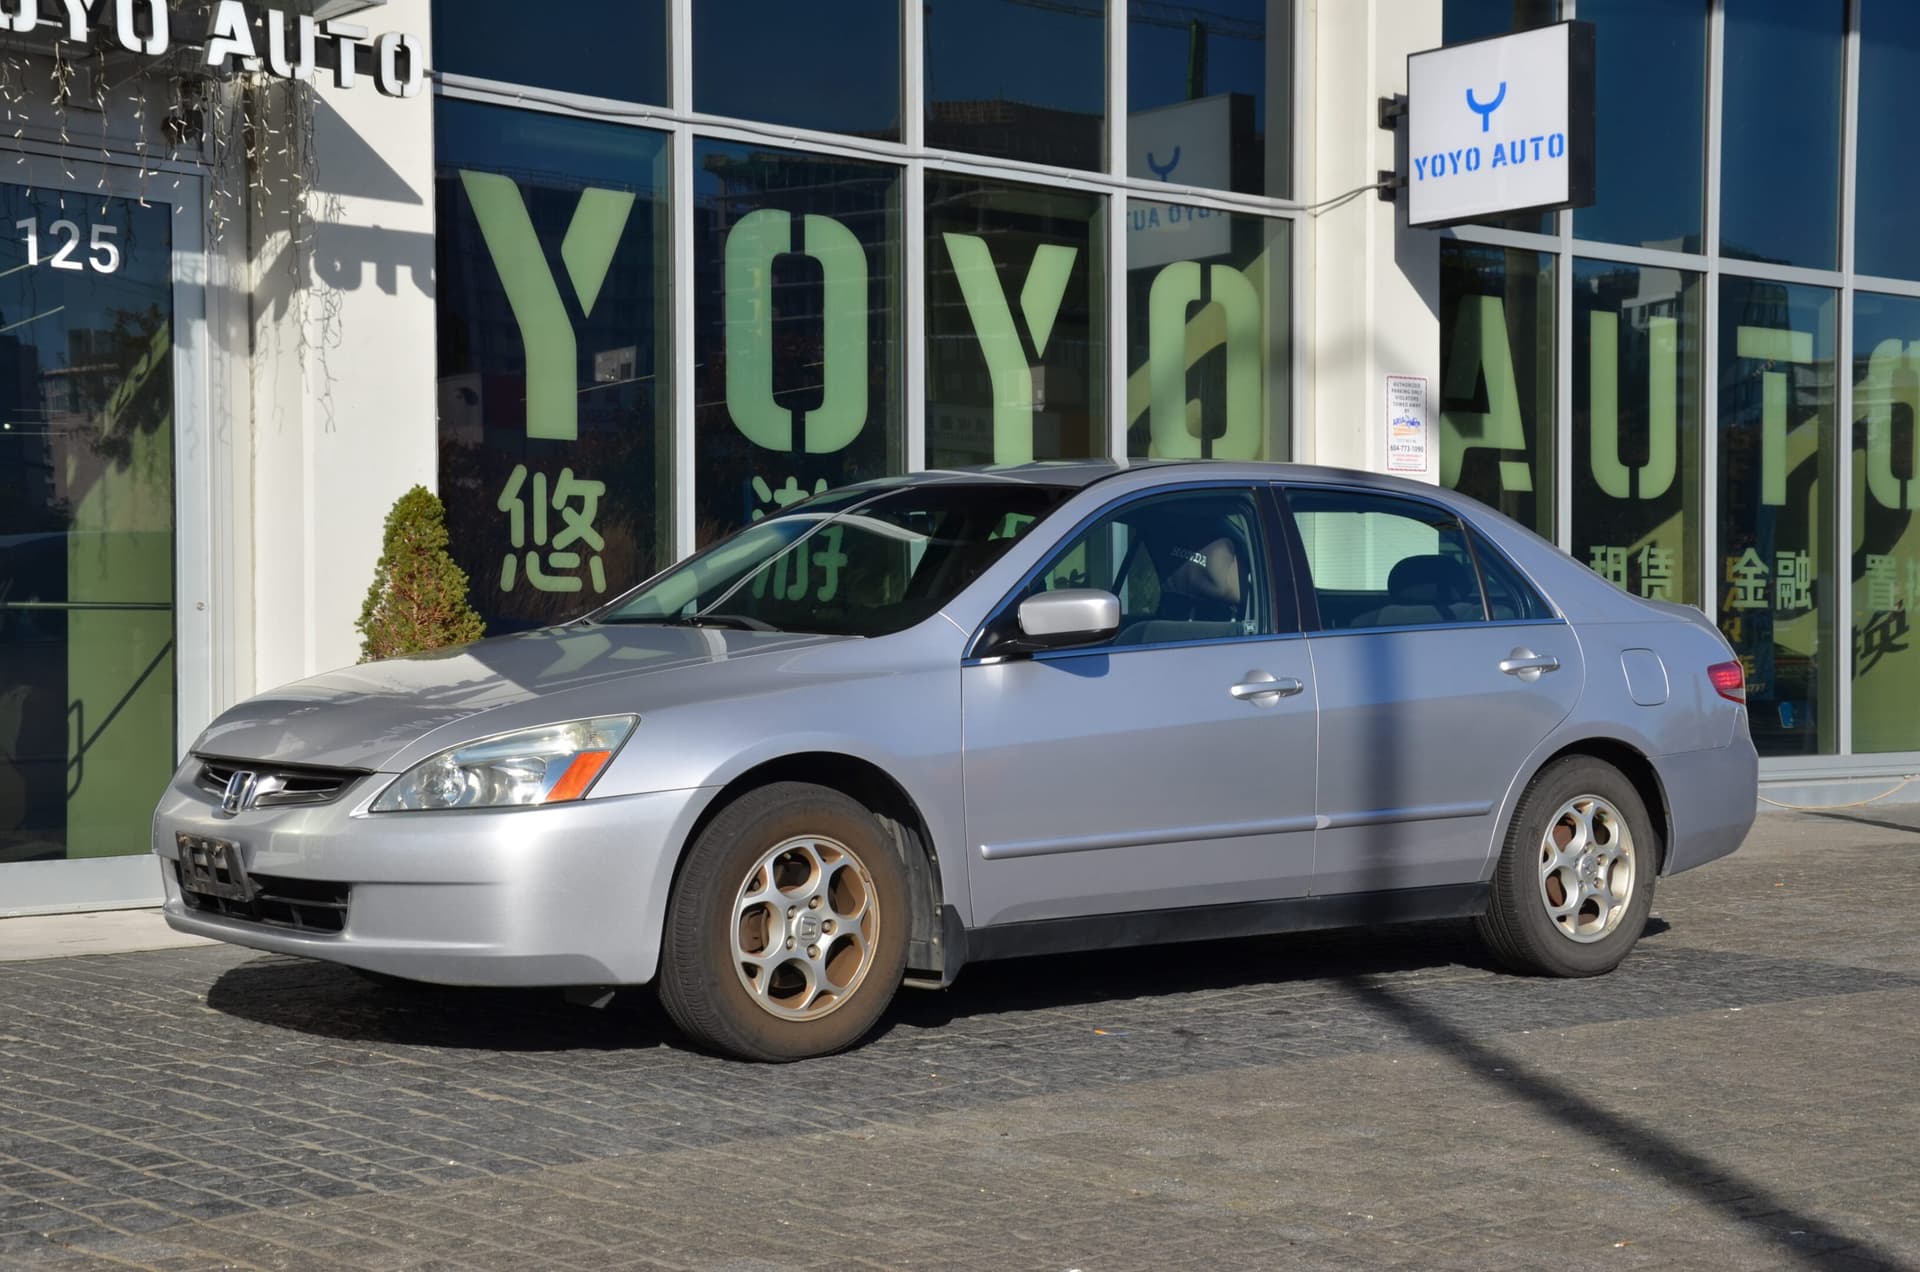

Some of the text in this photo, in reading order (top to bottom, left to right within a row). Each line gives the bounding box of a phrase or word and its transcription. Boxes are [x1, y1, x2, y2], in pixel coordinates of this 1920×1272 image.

[202, 0, 424, 98] AUTO
[1414, 132, 1565, 181] YOYO AUTO
[15, 216, 121, 275] 125
[458, 168, 1262, 466] YOYO
[1732, 547, 1813, 611] 金融
